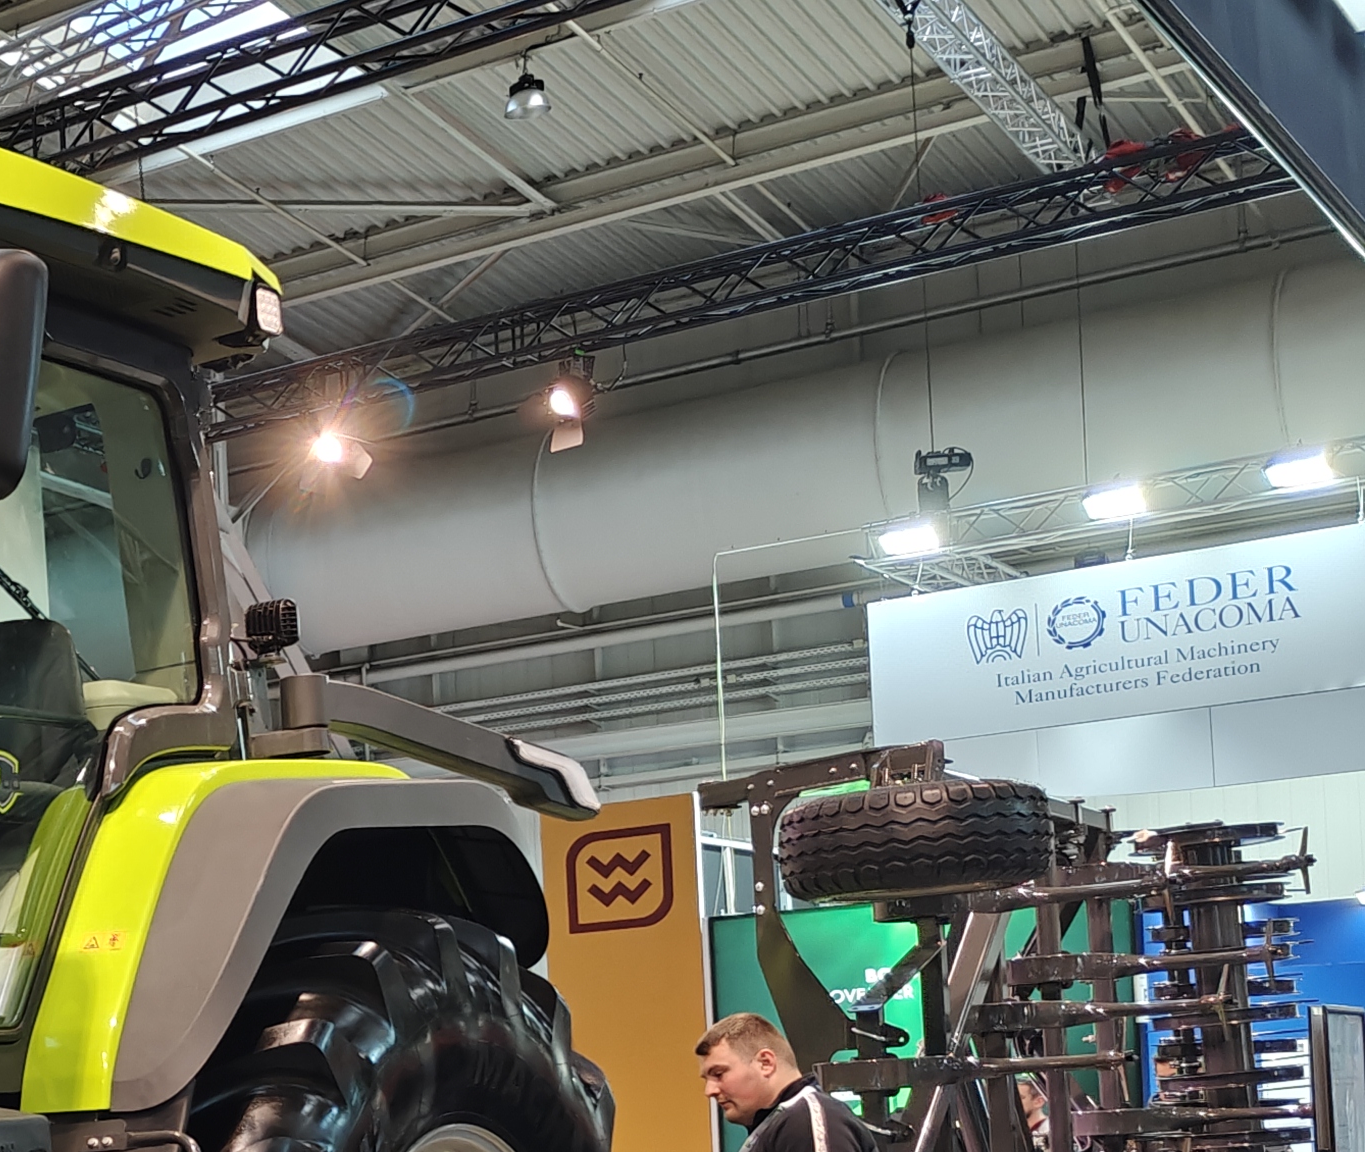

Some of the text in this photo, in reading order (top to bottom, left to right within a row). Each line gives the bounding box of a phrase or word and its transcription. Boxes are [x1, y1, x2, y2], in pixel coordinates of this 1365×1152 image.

[1118, 564, 1297, 617] FEDER
[1119, 596, 1302, 645] UNACOMA
[996, 638, 1280, 688] Italian Agricultural Machinery
[1014, 662, 1261, 705] Manufacturers Federation
